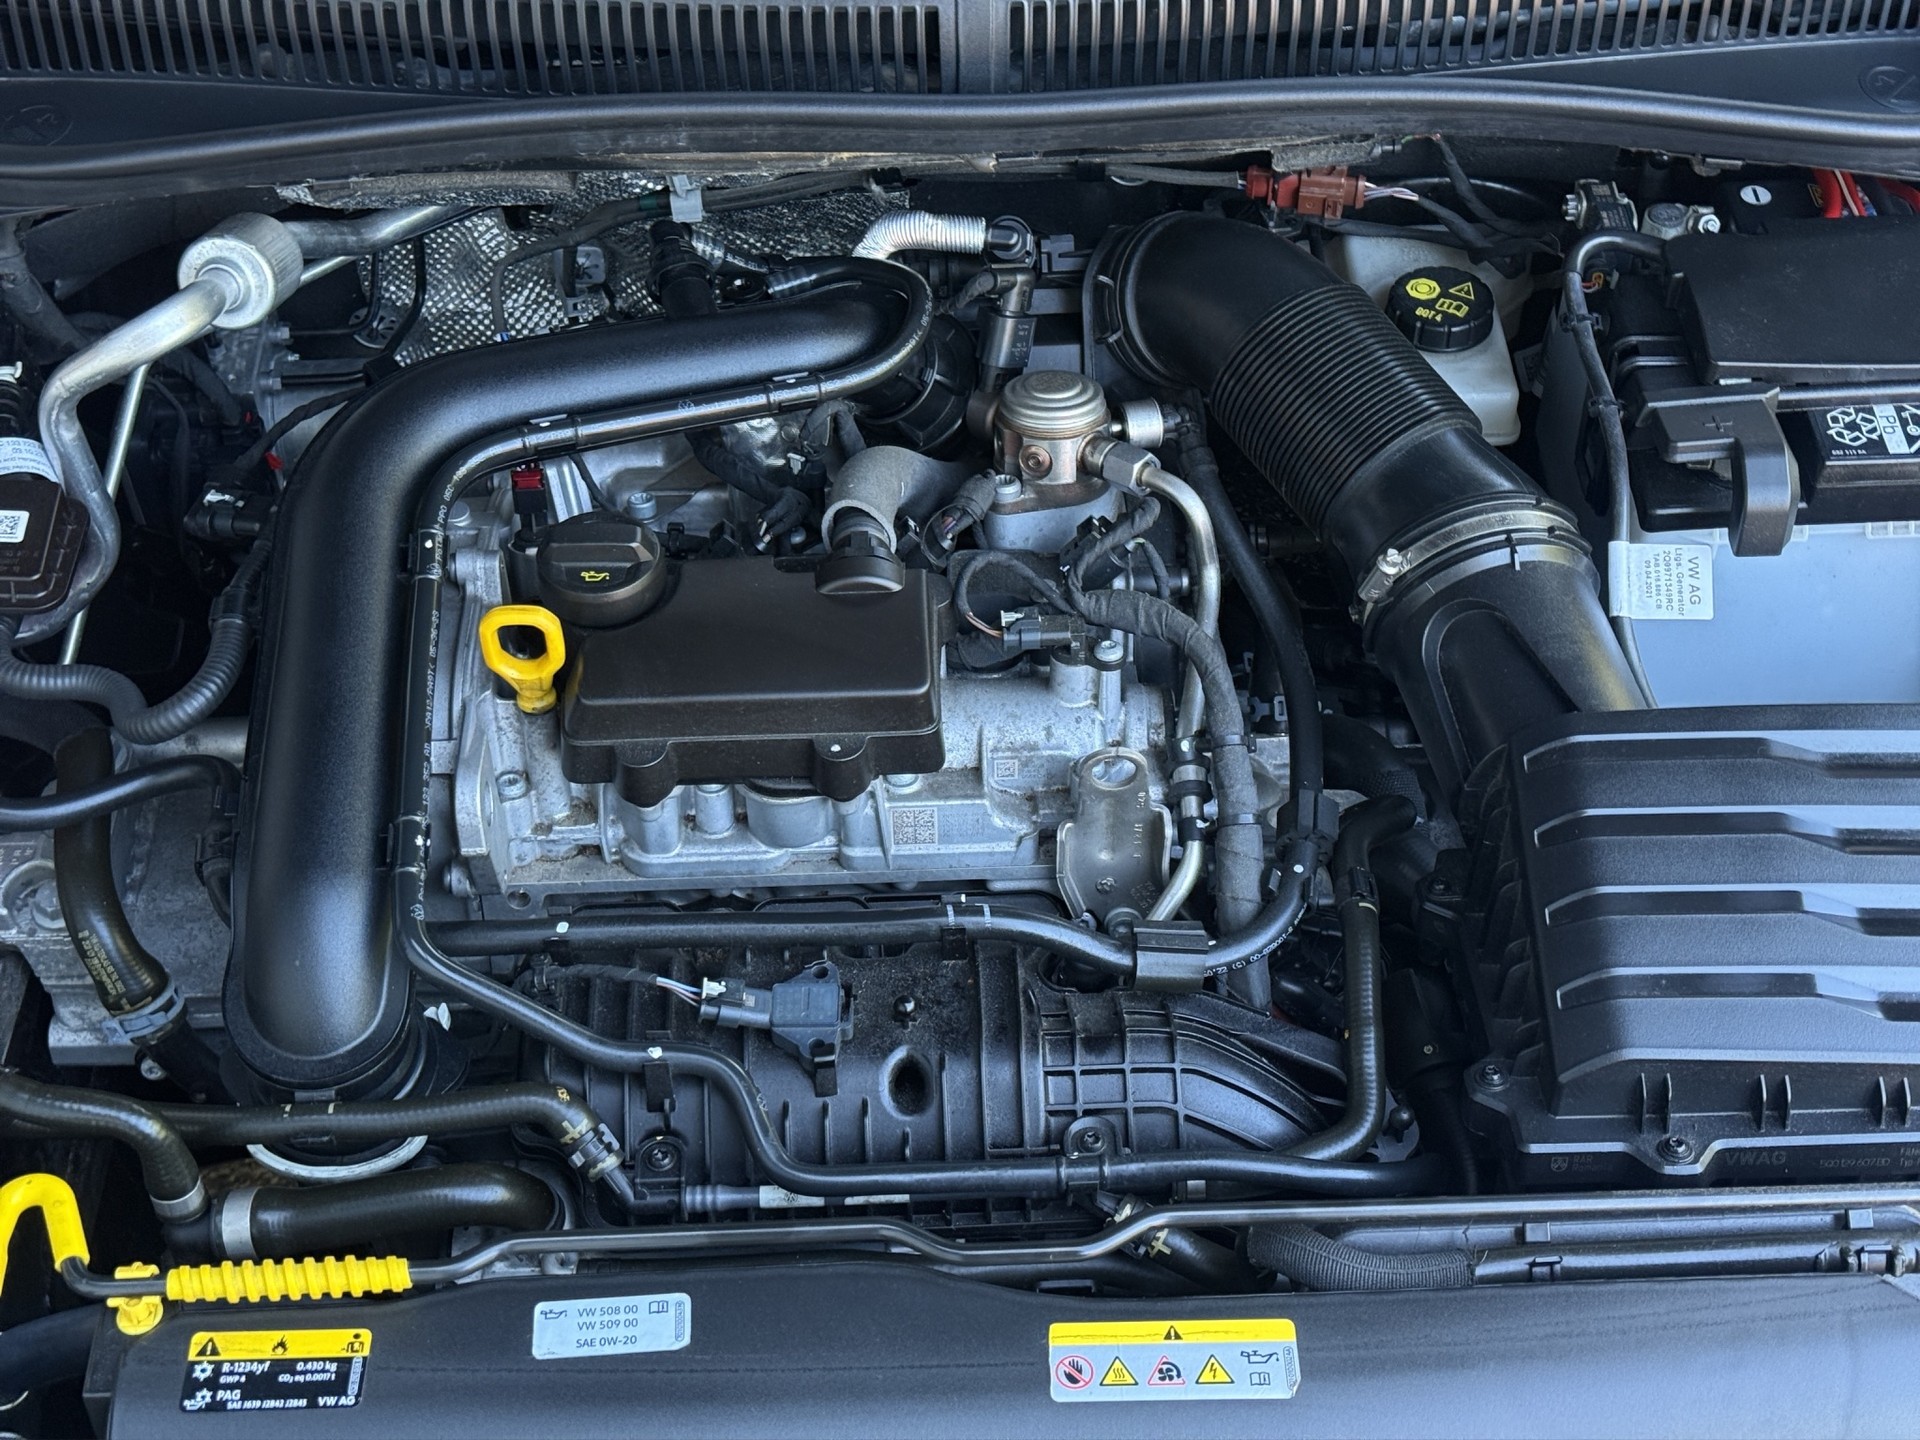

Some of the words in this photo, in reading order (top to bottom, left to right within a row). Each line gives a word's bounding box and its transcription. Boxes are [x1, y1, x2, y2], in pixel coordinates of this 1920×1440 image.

[1879, 415, 1898, 434] Pb
[1687, 556, 1700, 580] VW
[1676, 572, 1685, 616] Generator
[1689, 584, 1701, 605] AG
[577, 1308, 596, 1317] VW
[600, 1306, 621, 1316] 508
[623, 1305, 638, 1314] 00
[577, 1321, 596, 1331] VW
[600, 1319, 621, 1329] 509
[623, 1318, 638, 1328] 00
[576, 1338, 596, 1348] SAE
[599, 1335, 637, 1346] 0W-20
[222, 1361, 271, 1376] R-1234yf
[296, 1362, 323, 1371] 0.430
[325, 1361, 338, 1372] kg
[219, 1375, 239, 1384] GWP
[216, 1390, 241, 1401] PAG
[317, 1397, 339, 1407] VW
[339, 1396, 356, 1406] AG
